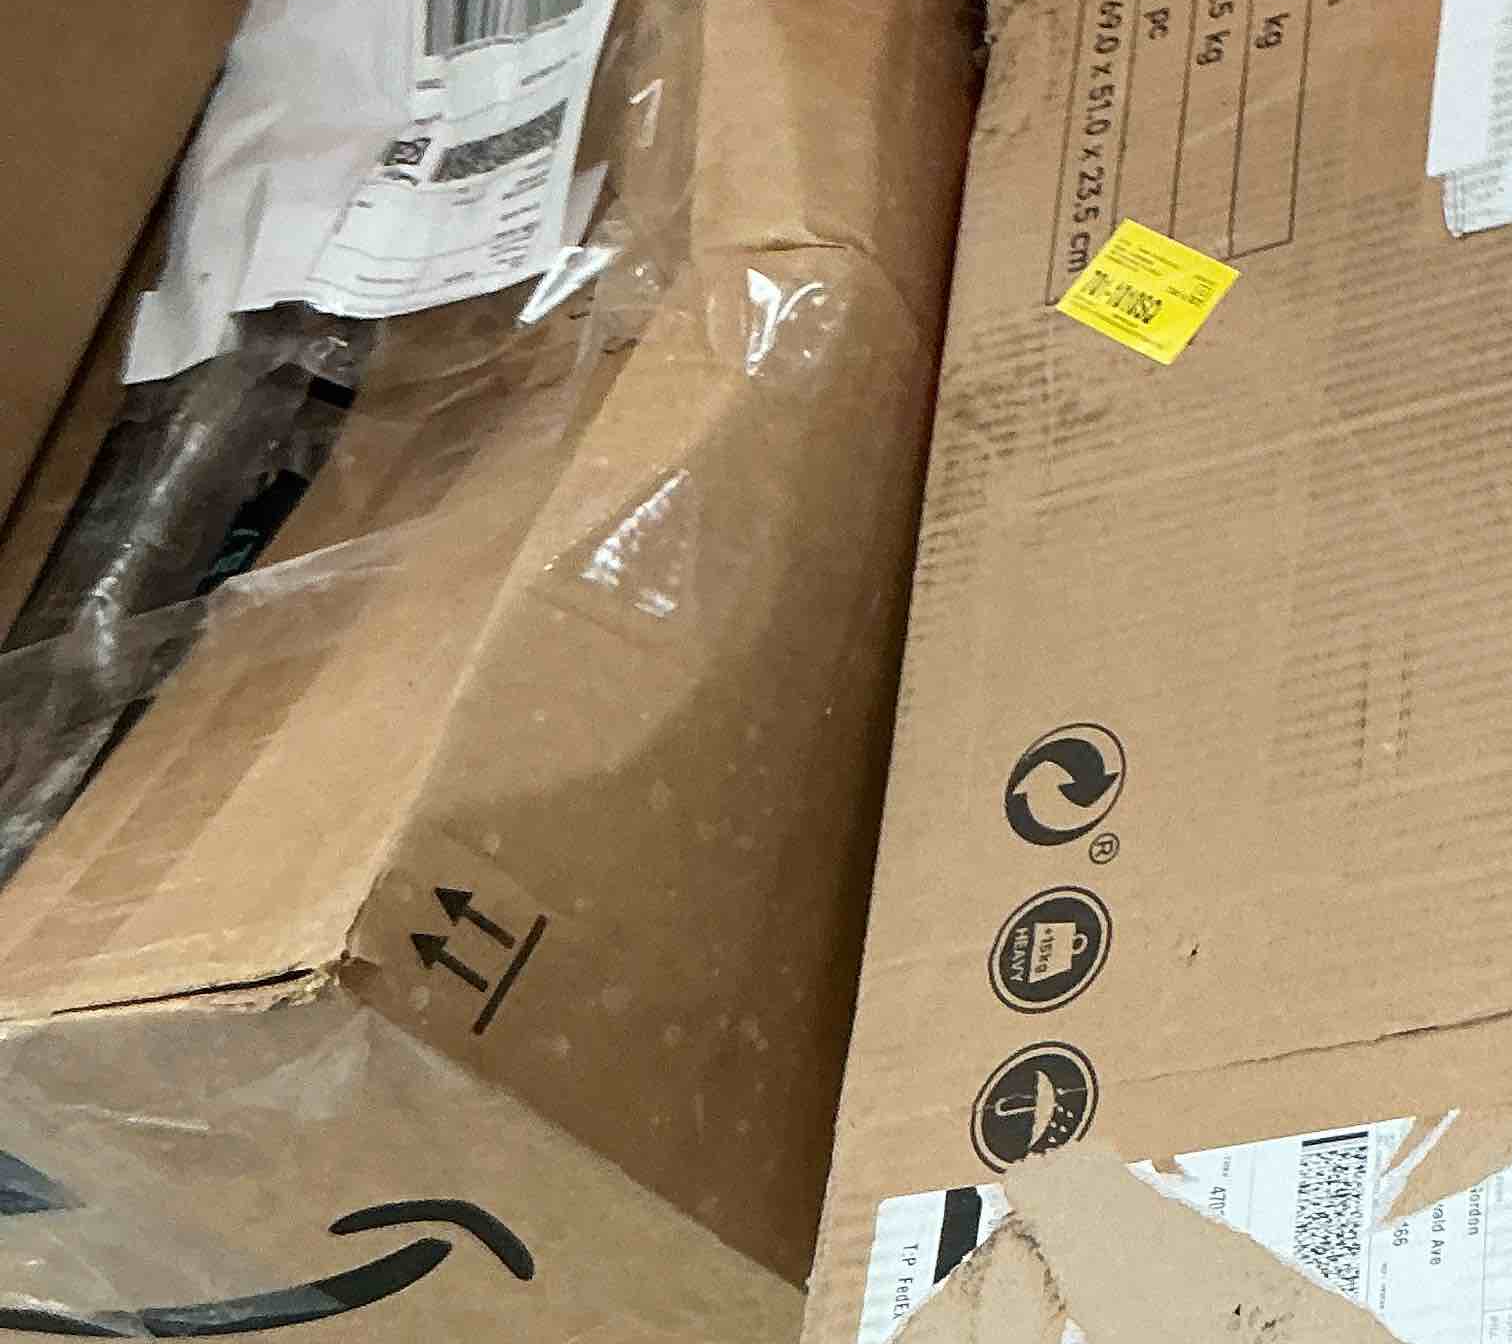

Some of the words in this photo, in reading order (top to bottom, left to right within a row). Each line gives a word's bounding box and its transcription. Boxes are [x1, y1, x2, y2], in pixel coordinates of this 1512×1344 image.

[1144, 7, 1170, 40] pc
[1256, 12, 1290, 49] kg
[1196, 29, 1231, 66] kg
[1008, 927, 1028, 981] HEAVY
